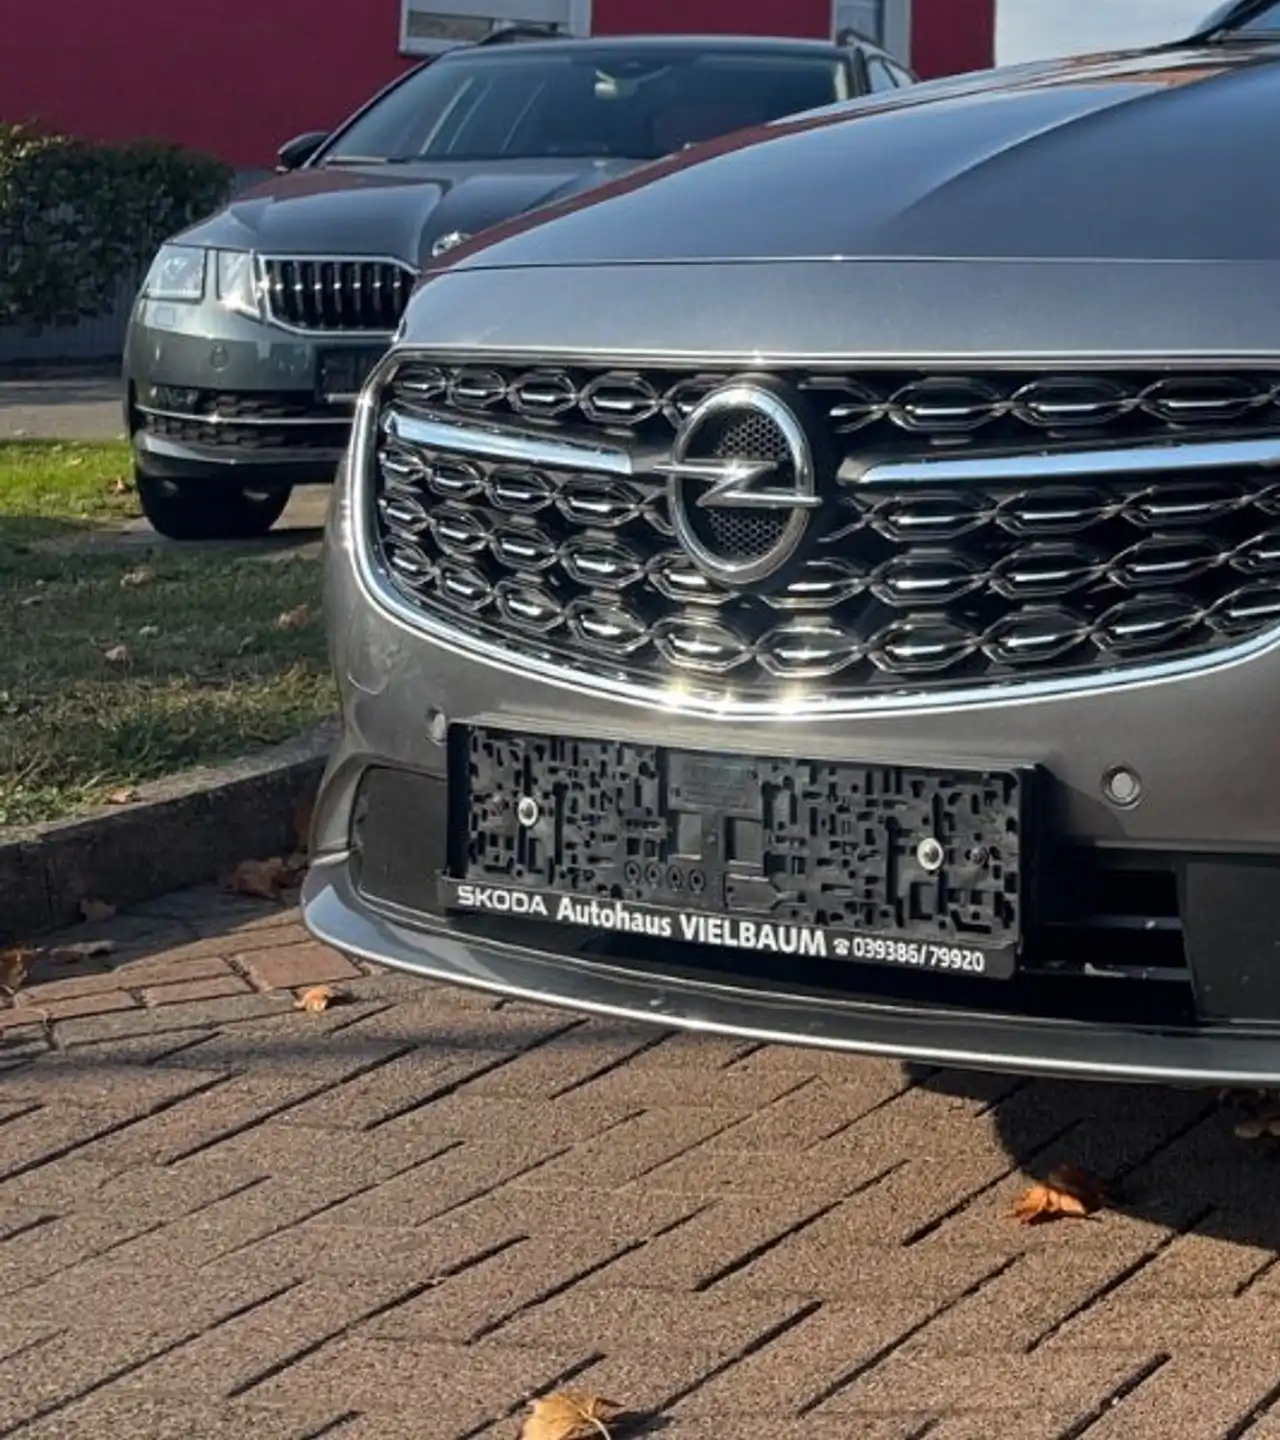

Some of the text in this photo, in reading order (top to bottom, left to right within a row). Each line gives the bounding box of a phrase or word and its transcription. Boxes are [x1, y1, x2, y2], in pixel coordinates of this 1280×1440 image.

[556, 897, 673, 938] Autohaus
[679, 913, 828, 957] VIELBAUM
[852, 937, 986, 973] 039386/79920
